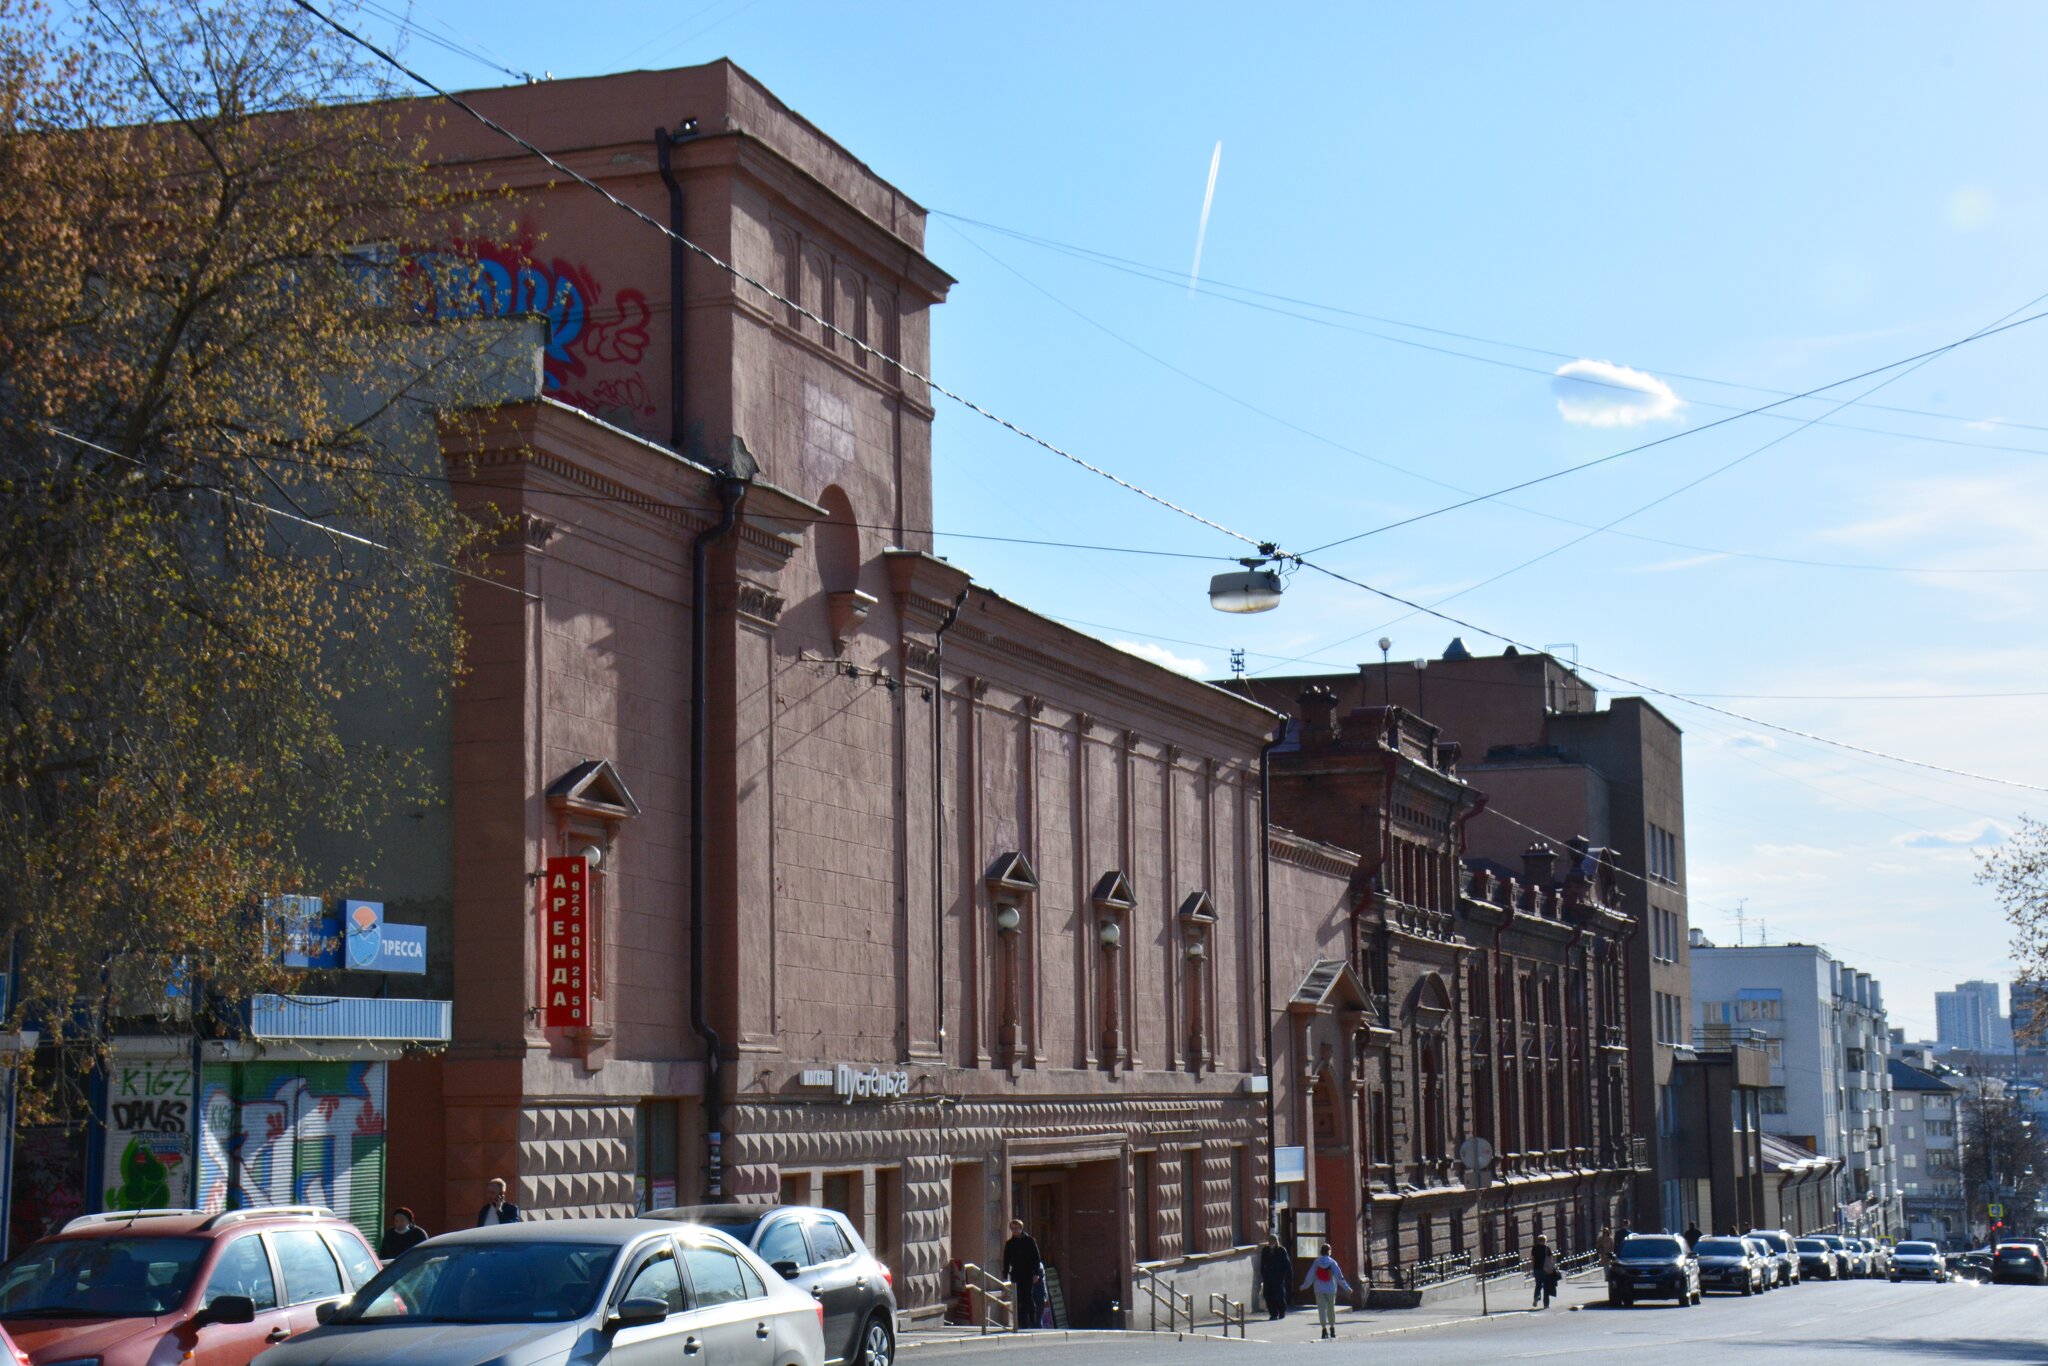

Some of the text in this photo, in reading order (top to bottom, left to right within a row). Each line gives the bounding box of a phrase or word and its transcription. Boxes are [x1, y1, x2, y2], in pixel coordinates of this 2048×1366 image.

[552, 873, 567, 1007] АРЕНДА
[571, 864, 580, 1019] 8 922 606 28 50
[836, 1064, 909, 1105] Пустельга
